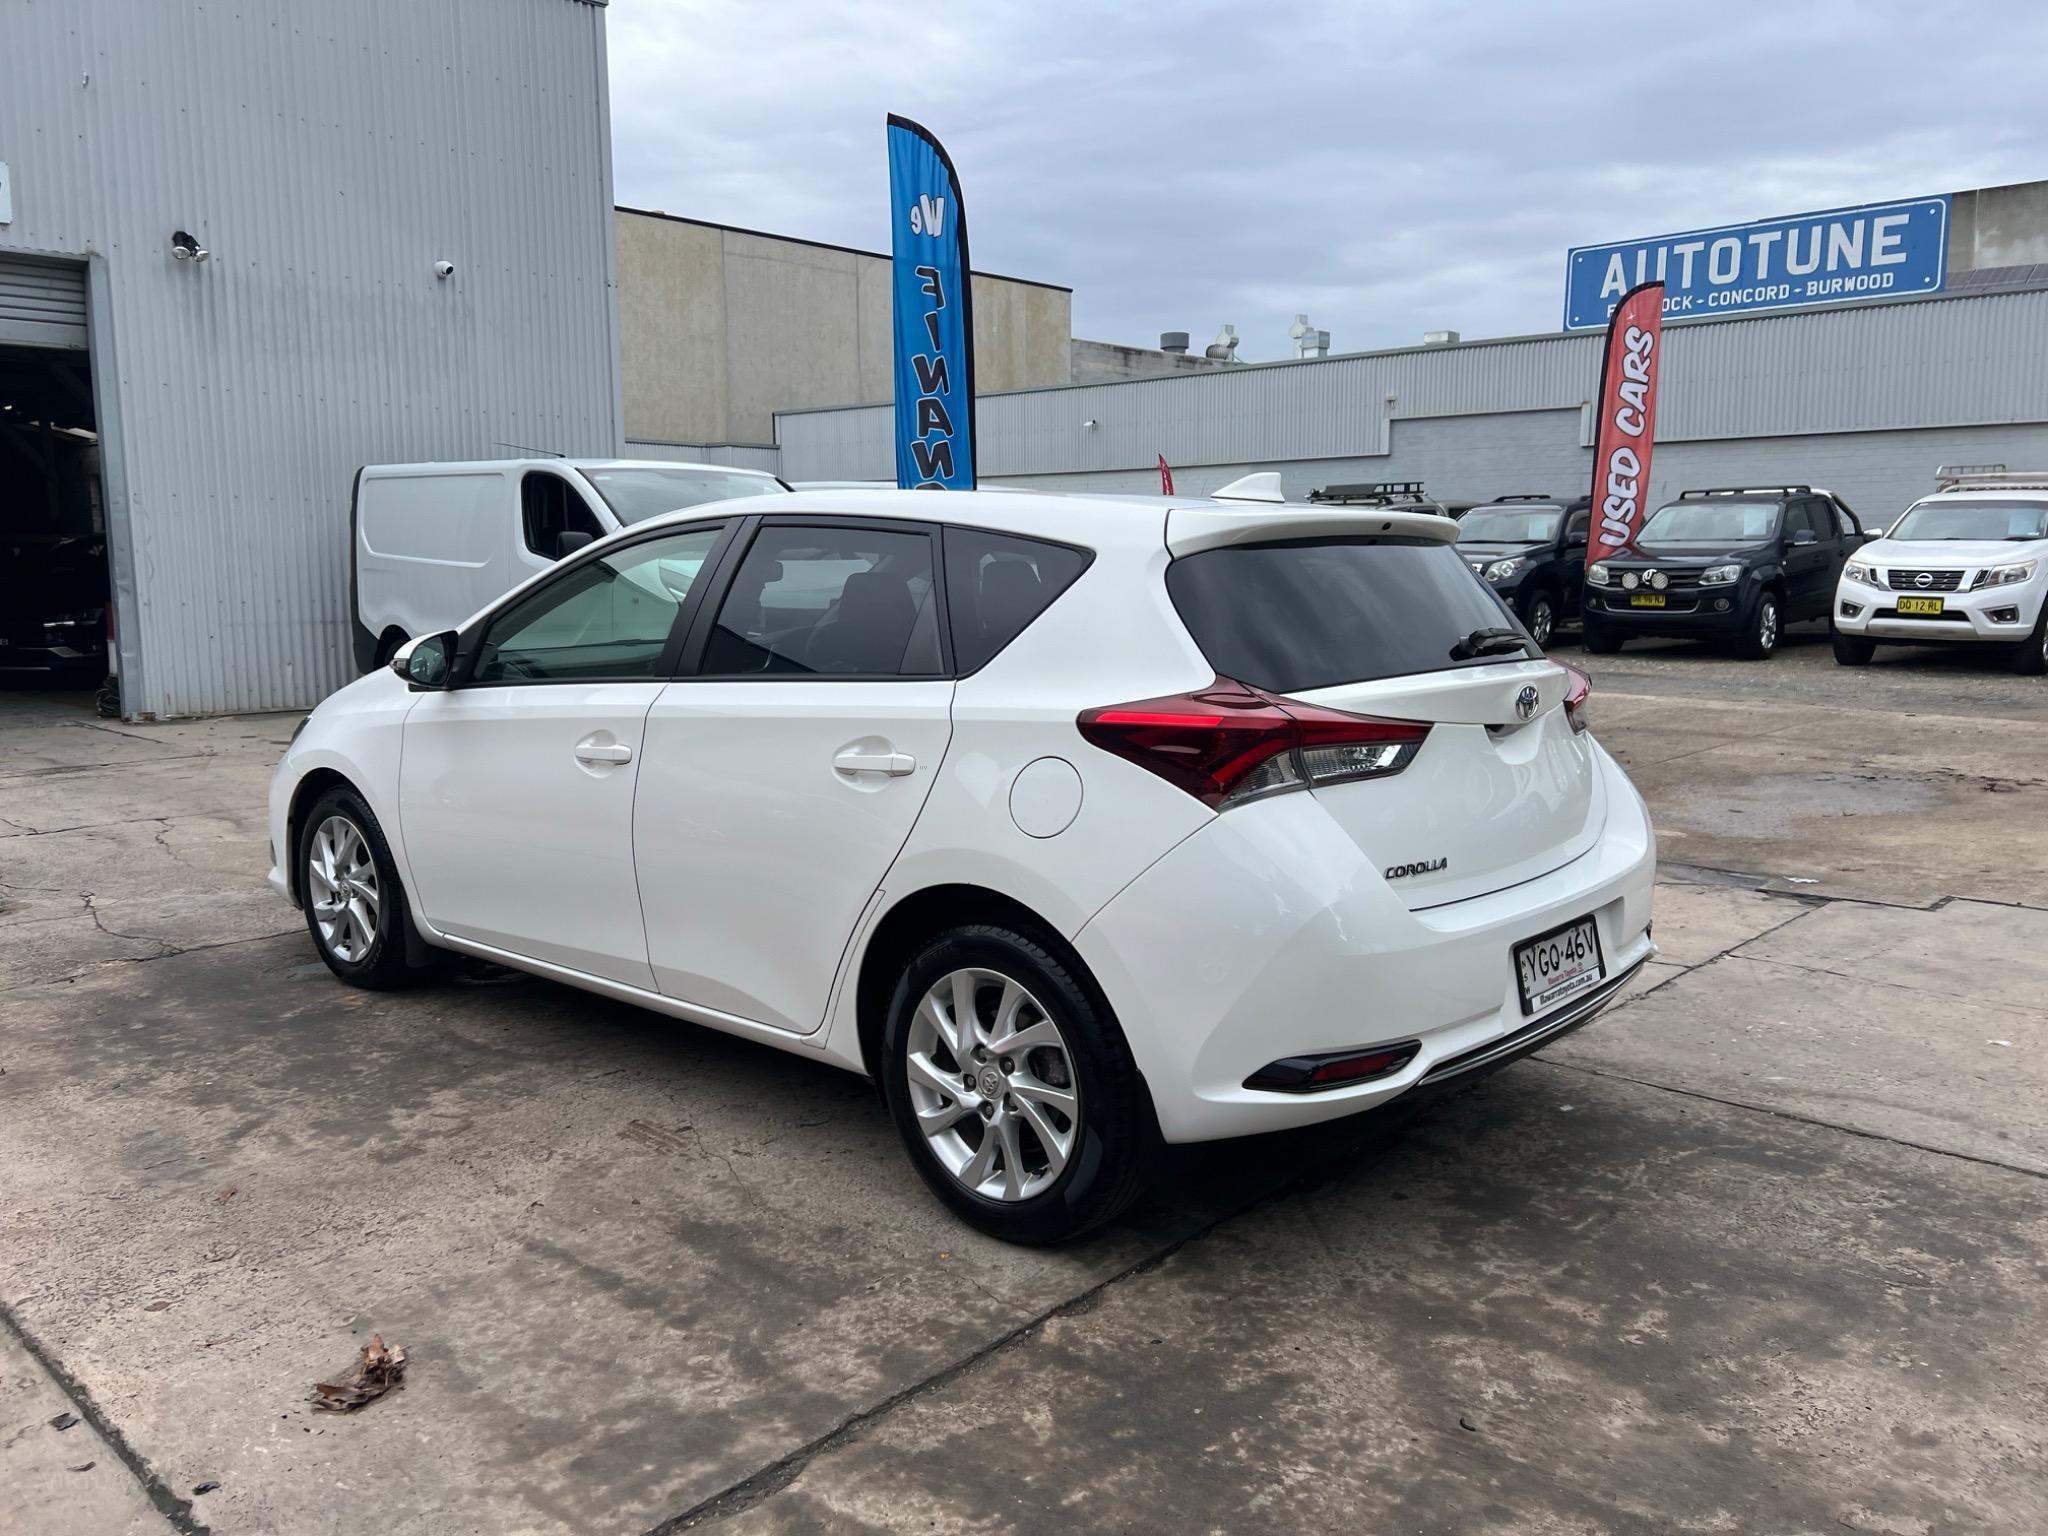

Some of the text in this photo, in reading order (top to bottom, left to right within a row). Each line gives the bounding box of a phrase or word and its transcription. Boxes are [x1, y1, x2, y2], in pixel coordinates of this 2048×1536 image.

[1599, 213, 1910, 300] AUTOTUNE
[1661, 272, 1894, 313] OCK CONCORD BURWOOD
[1599, 324, 1654, 547] USED CARS
[1384, 857, 1448, 879] COROLLA
